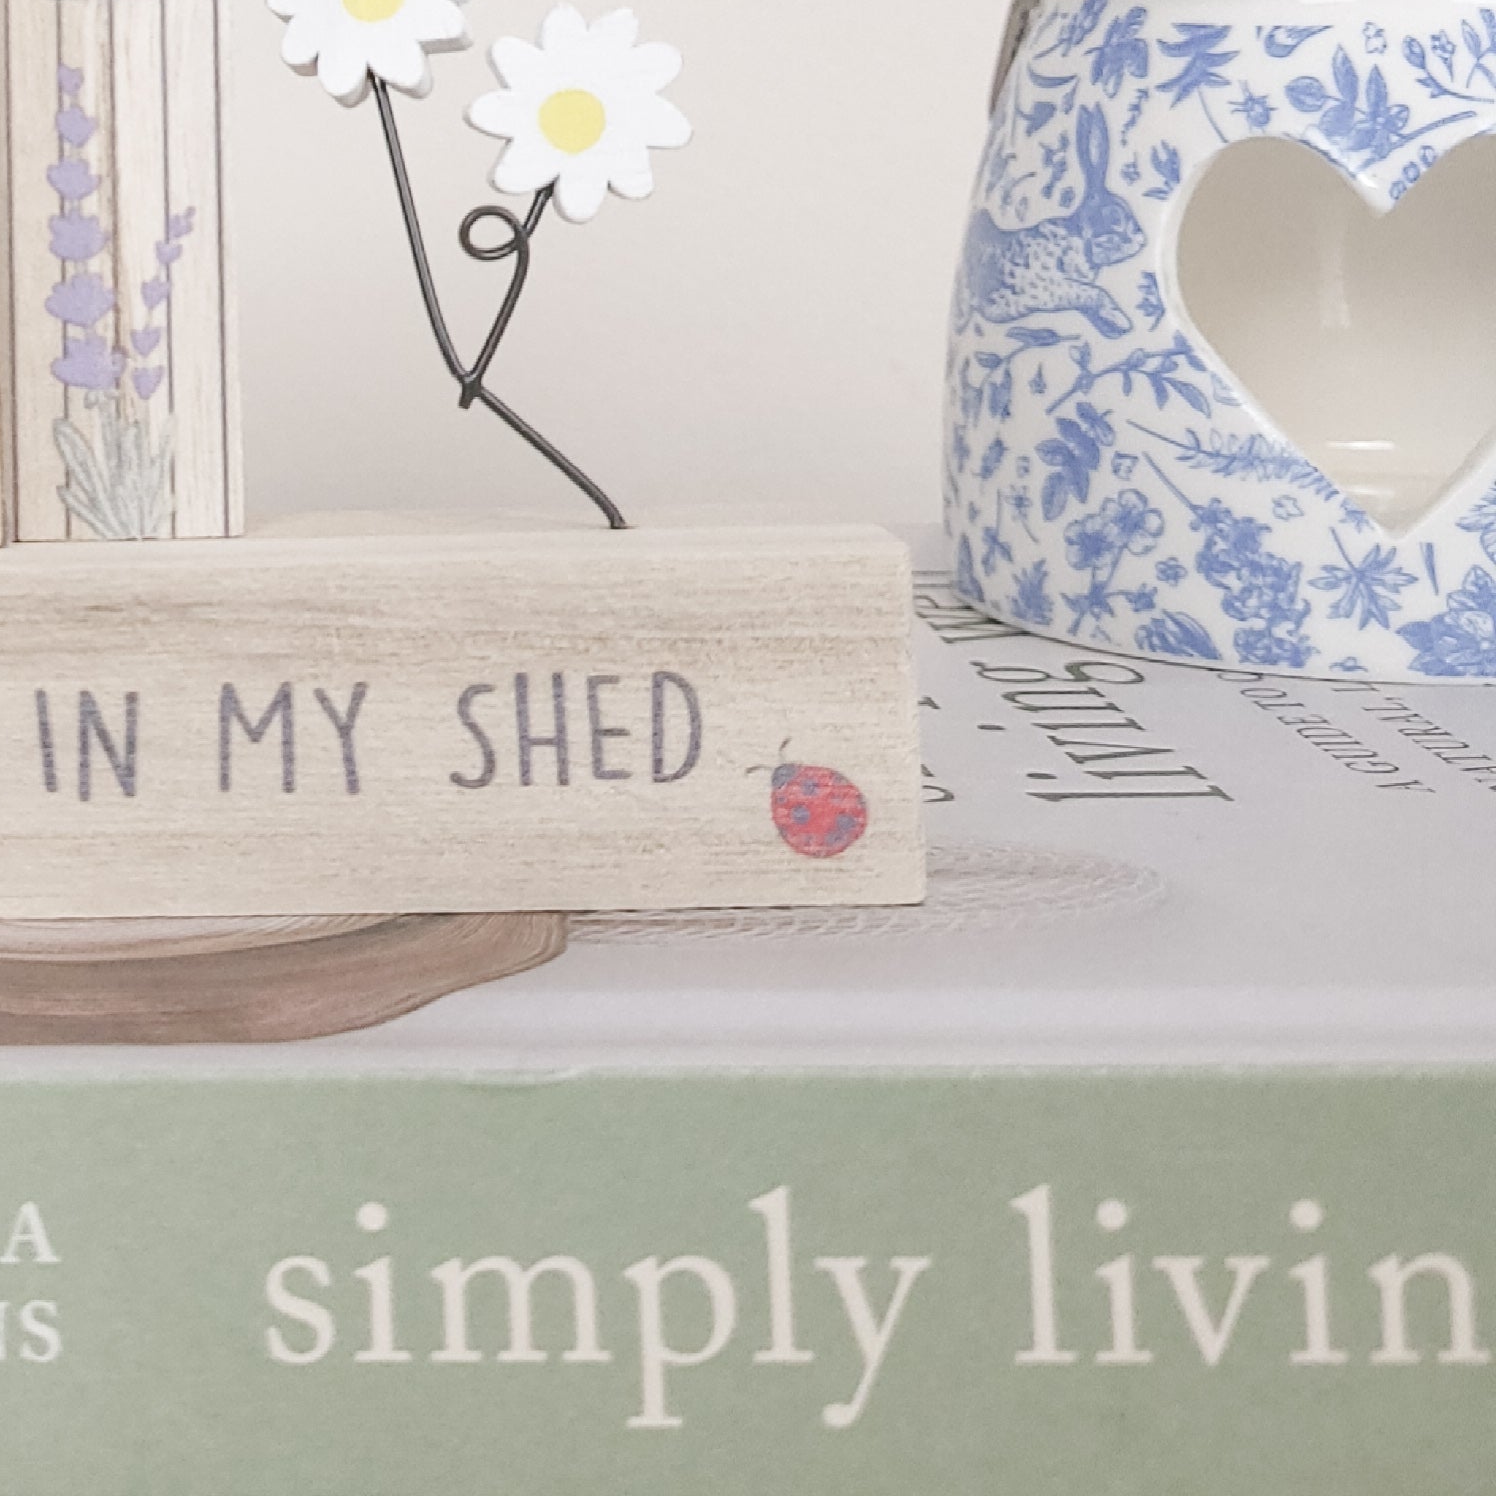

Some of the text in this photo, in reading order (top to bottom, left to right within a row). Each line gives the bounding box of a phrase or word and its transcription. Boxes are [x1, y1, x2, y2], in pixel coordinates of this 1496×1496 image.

[37, 689, 139, 802] IN
[218, 680, 367, 795] MY
[450, 670, 703, 788] SHED
[969, 661, 1235, 803] living
[1240, 687, 1436, 793] A GUIDE TO
[263, 1184, 1493, 1428] simply livin
